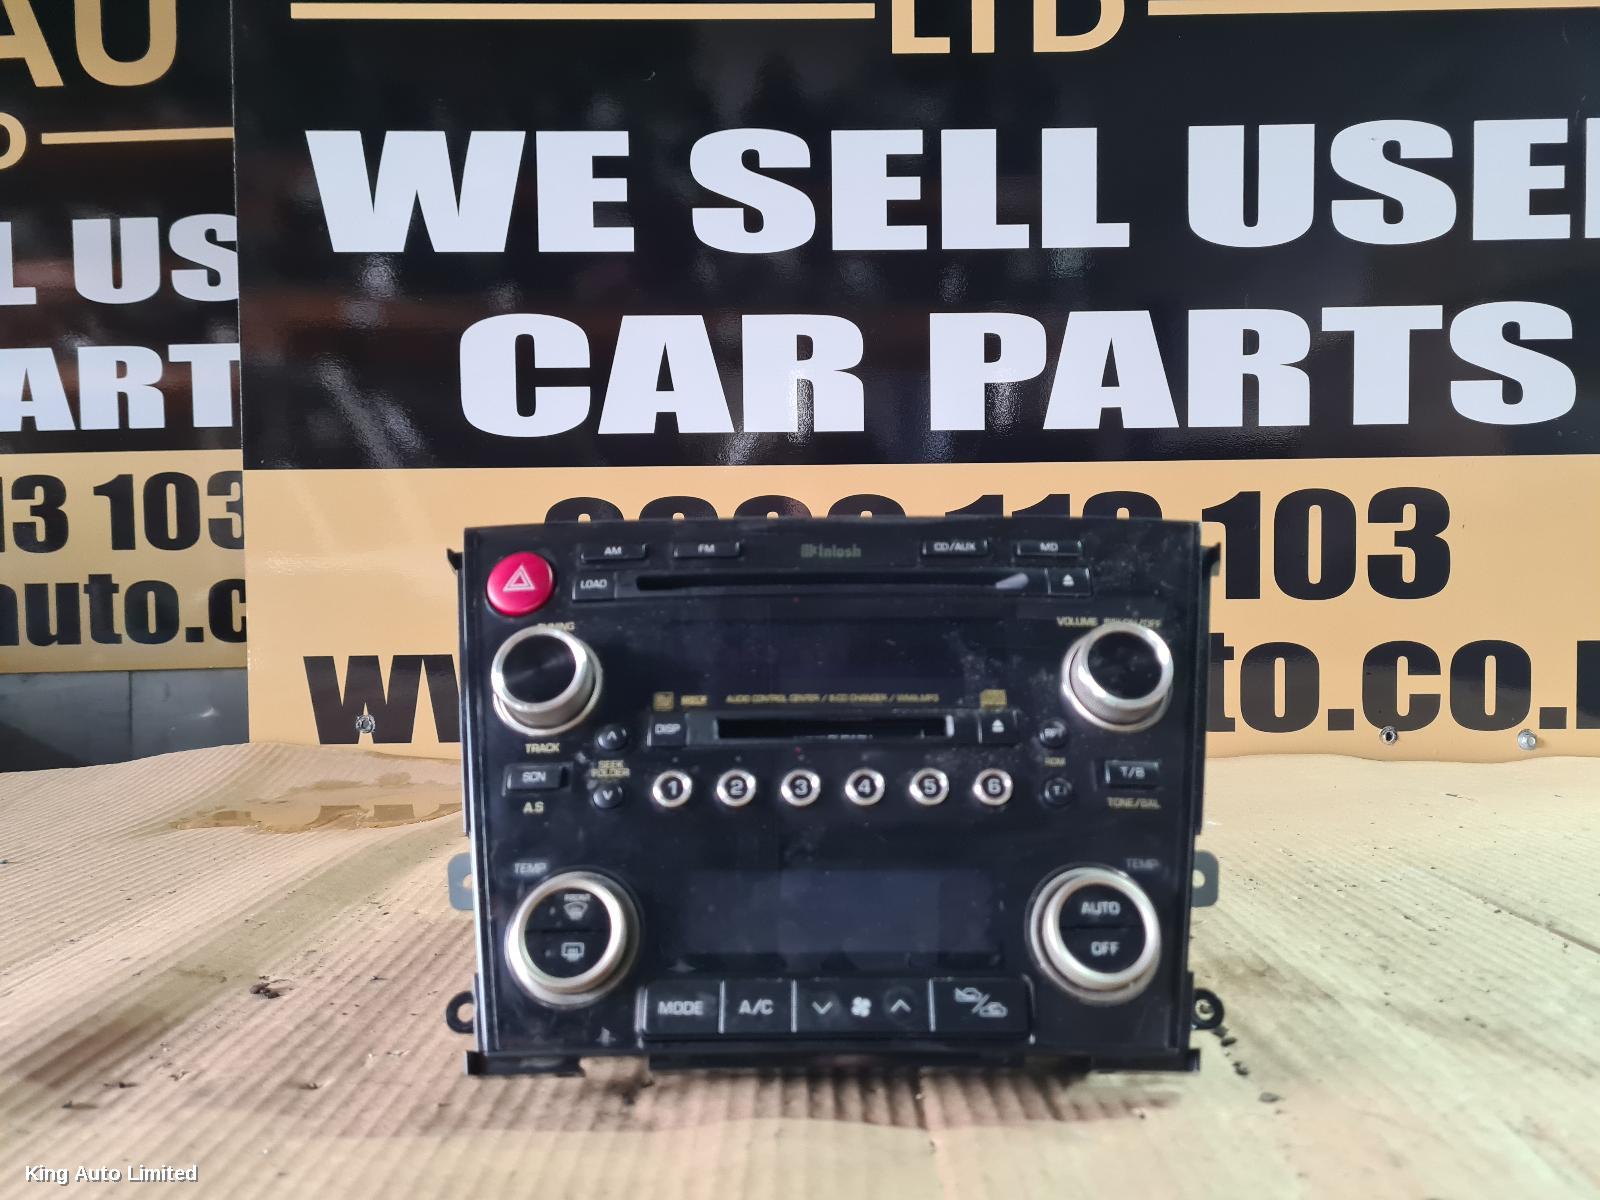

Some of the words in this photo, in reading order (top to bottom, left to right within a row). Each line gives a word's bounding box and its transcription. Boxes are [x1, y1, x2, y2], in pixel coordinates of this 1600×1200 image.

[305, 130, 635, 253] WE
[690, 127, 1130, 252] SELL
[1187, 118, 1600, 248] USE
[459, 312, 865, 437] CAR
[928, 301, 1577, 430] PARTS
[0, 474, 69, 553] 3
[93, 470, 244, 551] 103
[933, 542, 976, 552] CD/AUX
[1201, 486, 1451, 600] 103
[580, 579, 607, 589] LOAD
[1056, 616, 1098, 627] VOLUME
[525, 743, 560, 753] TRACK
[668, 781, 679, 795] 1
[729, 780, 744, 795] 2
[795, 780, 808, 795] 3
[857, 779, 871, 794] 4
[923, 778, 936, 794] 5
[987, 778, 1001, 794] 6
[514, 863, 547, 874] TEMP
[1081, 902, 1120, 914] AUTO
[1091, 942, 1119, 955] OFF
[658, 1001, 704, 1015] MODE
[739, 999, 773, 1015] A/C
